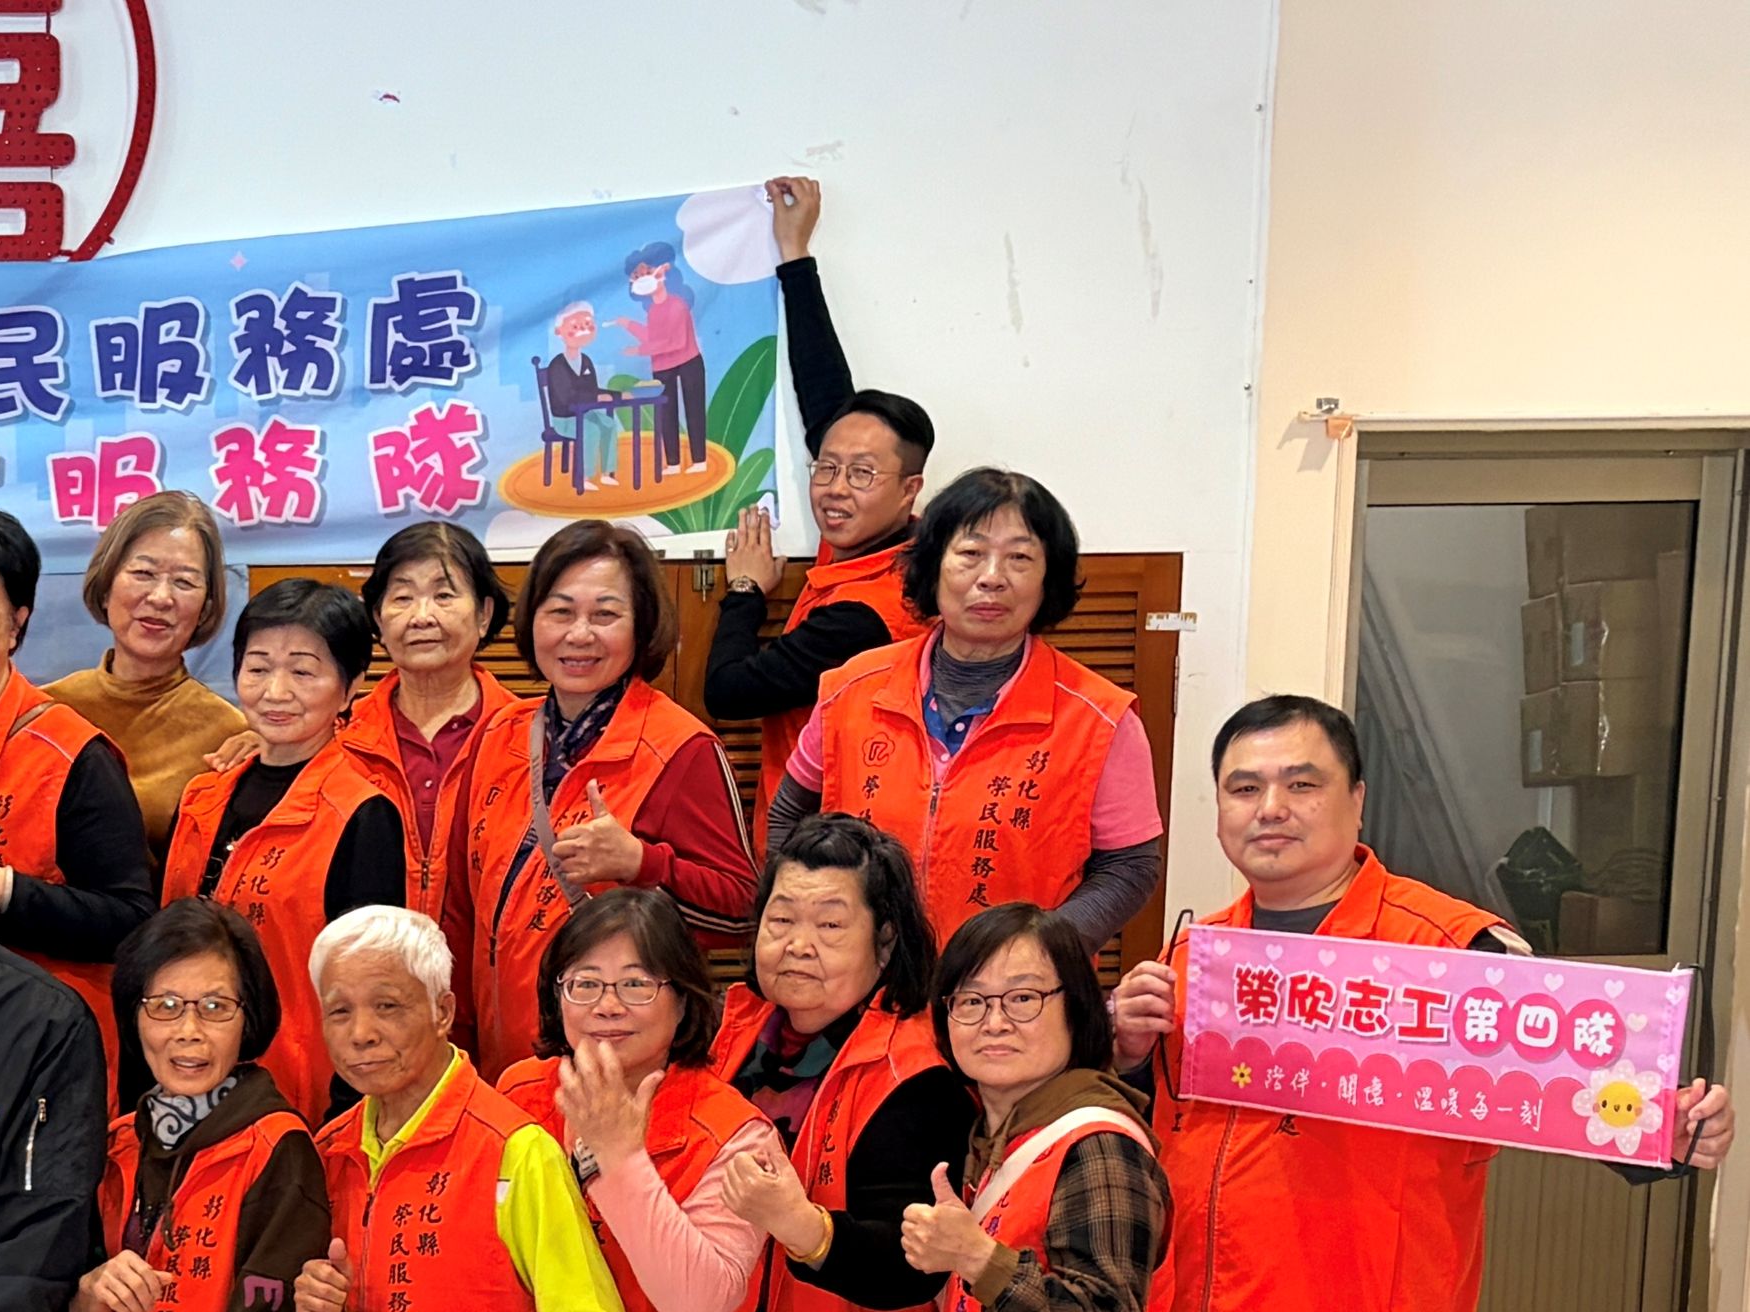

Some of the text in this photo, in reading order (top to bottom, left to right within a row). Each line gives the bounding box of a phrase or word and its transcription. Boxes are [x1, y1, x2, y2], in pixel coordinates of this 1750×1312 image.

[1009, 750, 1051, 831] 彰化縣
[966, 775, 1013, 908] 榮民服務處
[1233, 963, 1616, 1057] 榮欣志工第四隊
[189, 1194, 225, 1280] 彰化縣
[416, 1172, 451, 1257] 彰化縣
